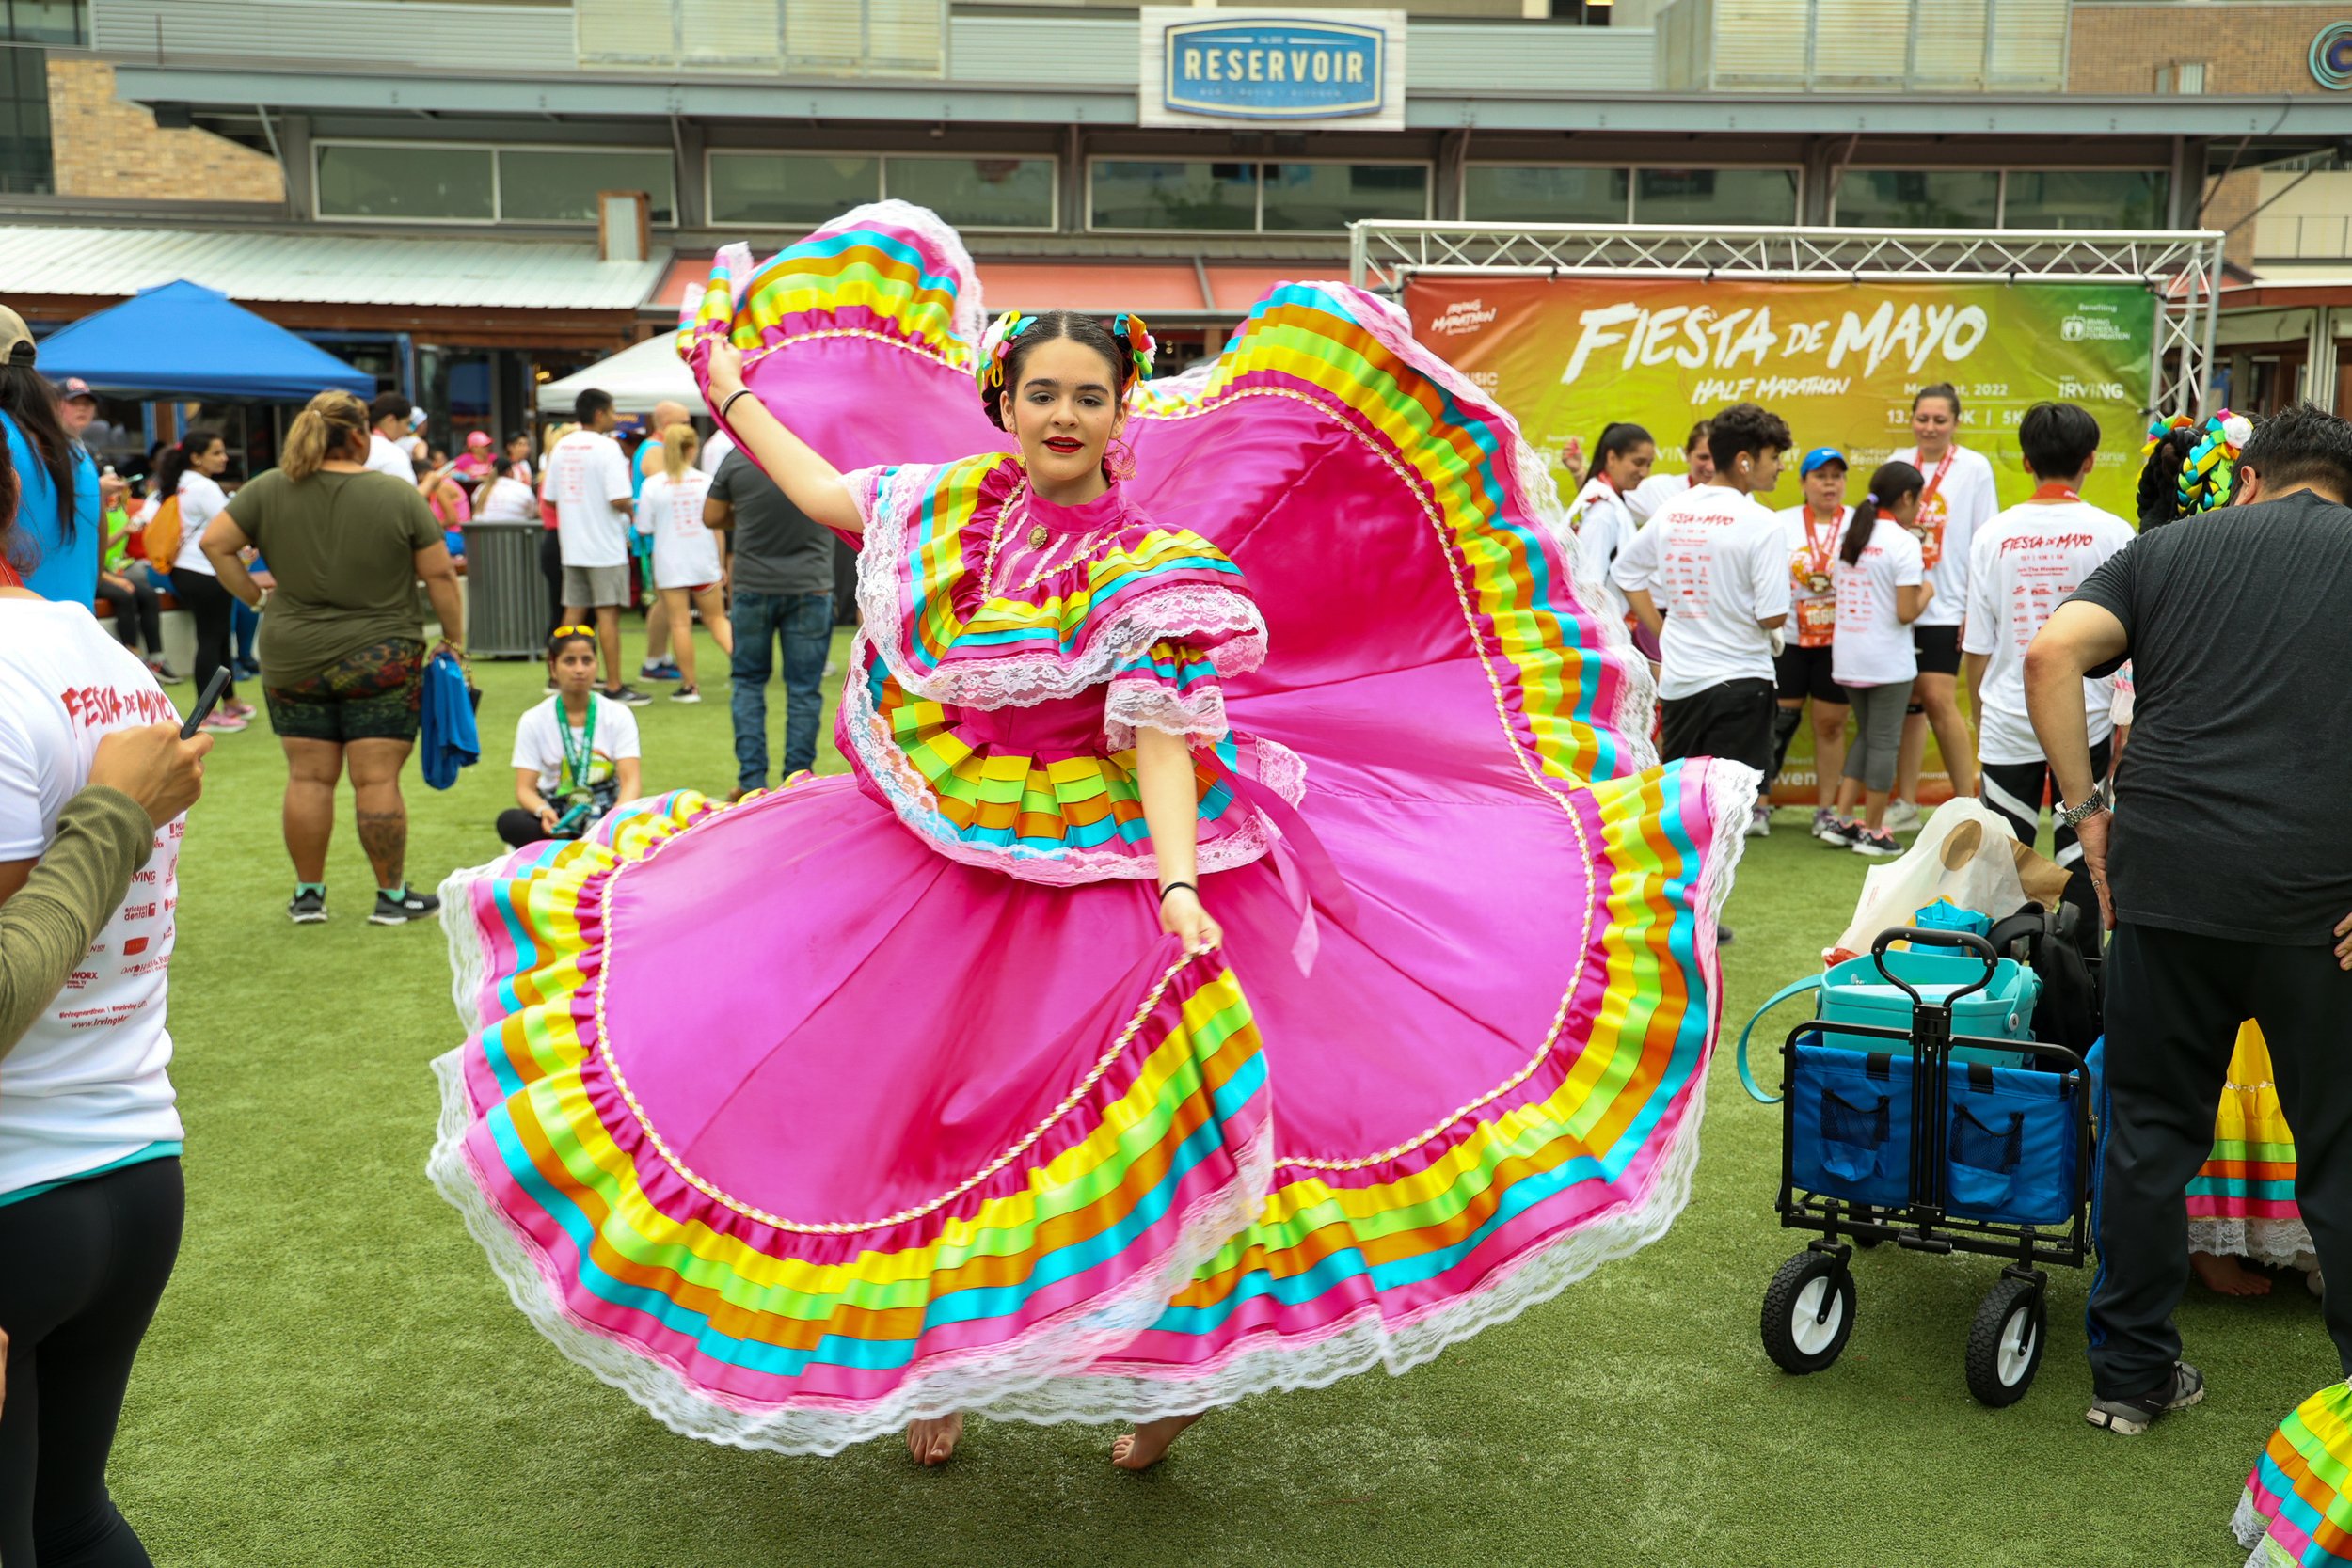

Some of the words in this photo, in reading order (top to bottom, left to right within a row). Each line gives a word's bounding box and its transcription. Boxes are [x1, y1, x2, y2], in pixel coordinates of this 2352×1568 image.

[1184, 48, 1363, 83] RESERVOIR
[1431, 308, 1497, 333] MARATHON
[1561, 302, 1776, 385] FIESTA
[1781, 320, 1830, 357] DE
[1826, 301, 1988, 378] MAYO
[1691, 377, 1756, 405] HALF
[1755, 375, 1851, 401] MARATHON
[1974, 384, 2008, 396] 2022
[2058, 382, 2124, 399] IRVING
[1999, 535, 2044, 560] FIESTA
[2056, 533, 2093, 550] MAYO
[122, 694, 137, 716] DE
[124, 911, 148, 922] dental
